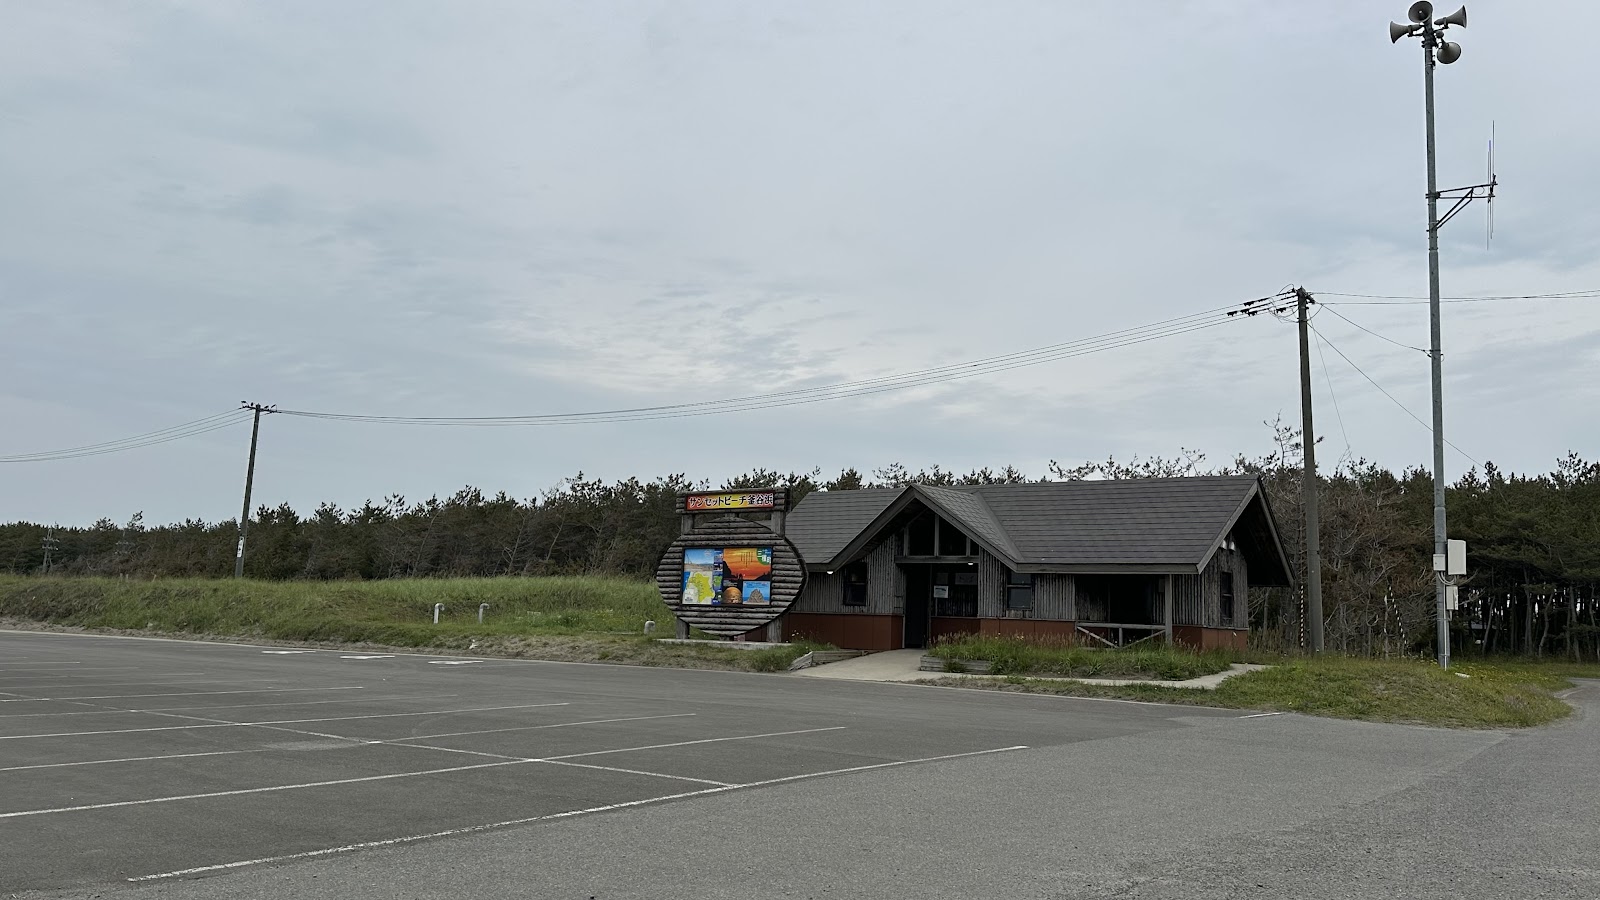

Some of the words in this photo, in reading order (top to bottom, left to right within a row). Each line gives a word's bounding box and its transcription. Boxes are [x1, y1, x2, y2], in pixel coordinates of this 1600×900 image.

[689, 493, 773, 507] サンセットビーチ釜谷浜
